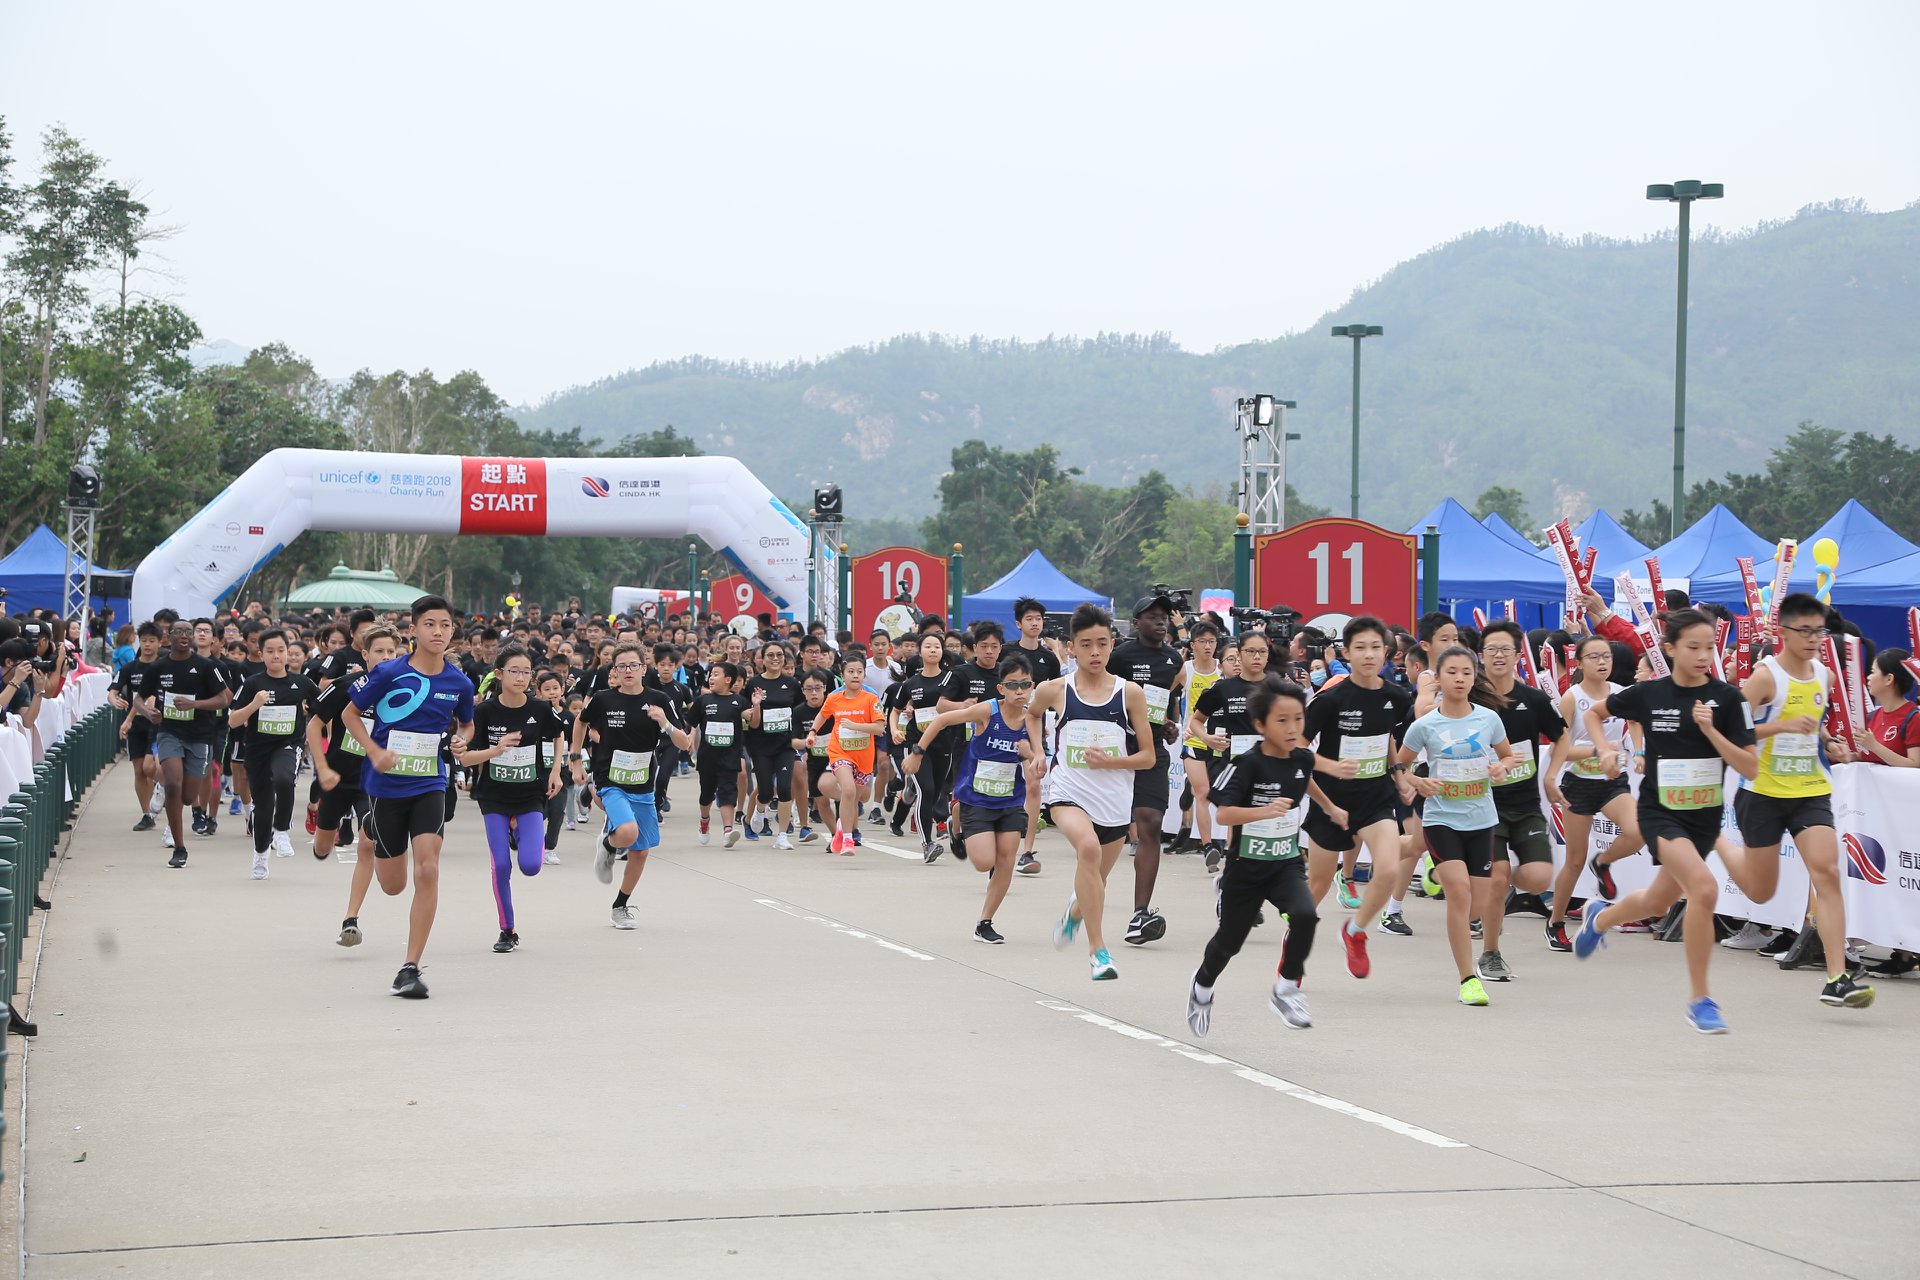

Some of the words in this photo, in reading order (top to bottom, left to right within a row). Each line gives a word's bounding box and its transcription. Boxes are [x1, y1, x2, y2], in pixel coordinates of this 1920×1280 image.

[320, 470, 363, 484] unicef
[481, 463, 527, 484] 起點
[390, 486, 424, 498] Charity
[426, 488, 445, 497] Run
[470, 494, 538, 511] START
[1308, 542, 1363, 604] 11
[878, 561, 921, 601] 10
[736, 583, 753, 612] 9
[261, 721, 292, 733] K1-020
[495, 766, 531, 780] F3-712
[1357, 760, 1384, 775] -023
[1506, 764, 1531, 780] -024
[613, 769, 645, 782] K1-008
[977, 780, 1010, 794] K1-007
[1443, 782, 1484, 798] K3-005
[1667, 788, 1716, 805] K4-027
[1248, 838, 1292, 856] F2-085
[1779, 845, 1795, 858] un
[1899, 876, 1920, 891] CIN
